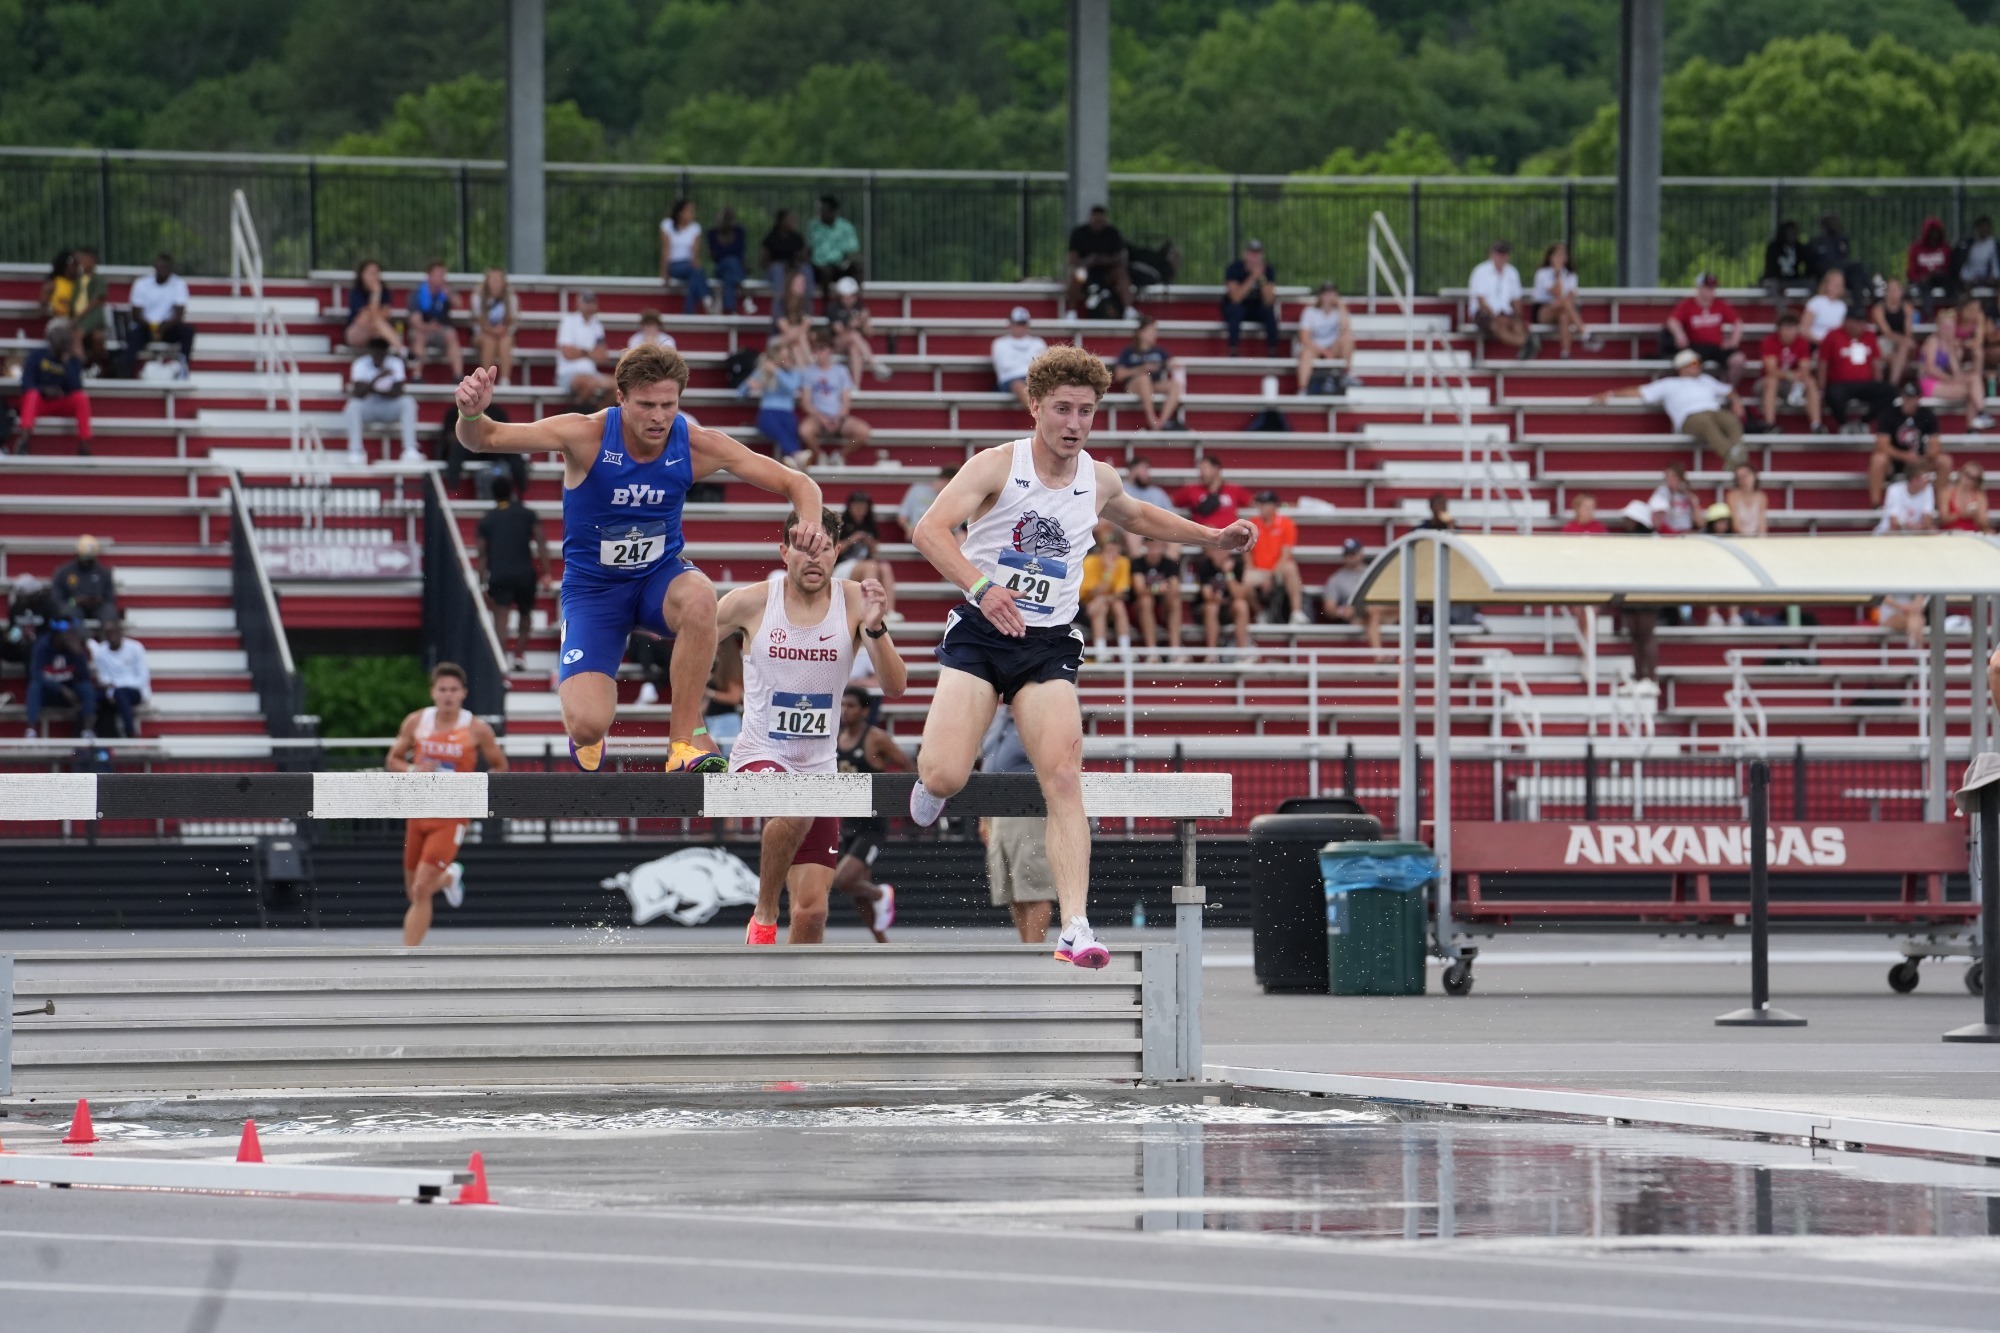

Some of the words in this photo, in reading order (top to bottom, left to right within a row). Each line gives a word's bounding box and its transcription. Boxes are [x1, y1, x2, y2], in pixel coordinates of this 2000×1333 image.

[611, 484, 666, 507] BYU
[613, 541, 653, 564] 247
[1006, 573, 1050, 603] 429
[770, 628, 787, 644] SEC
[769, 646, 838, 661] SOONERS
[777, 711, 826, 733] 1024
